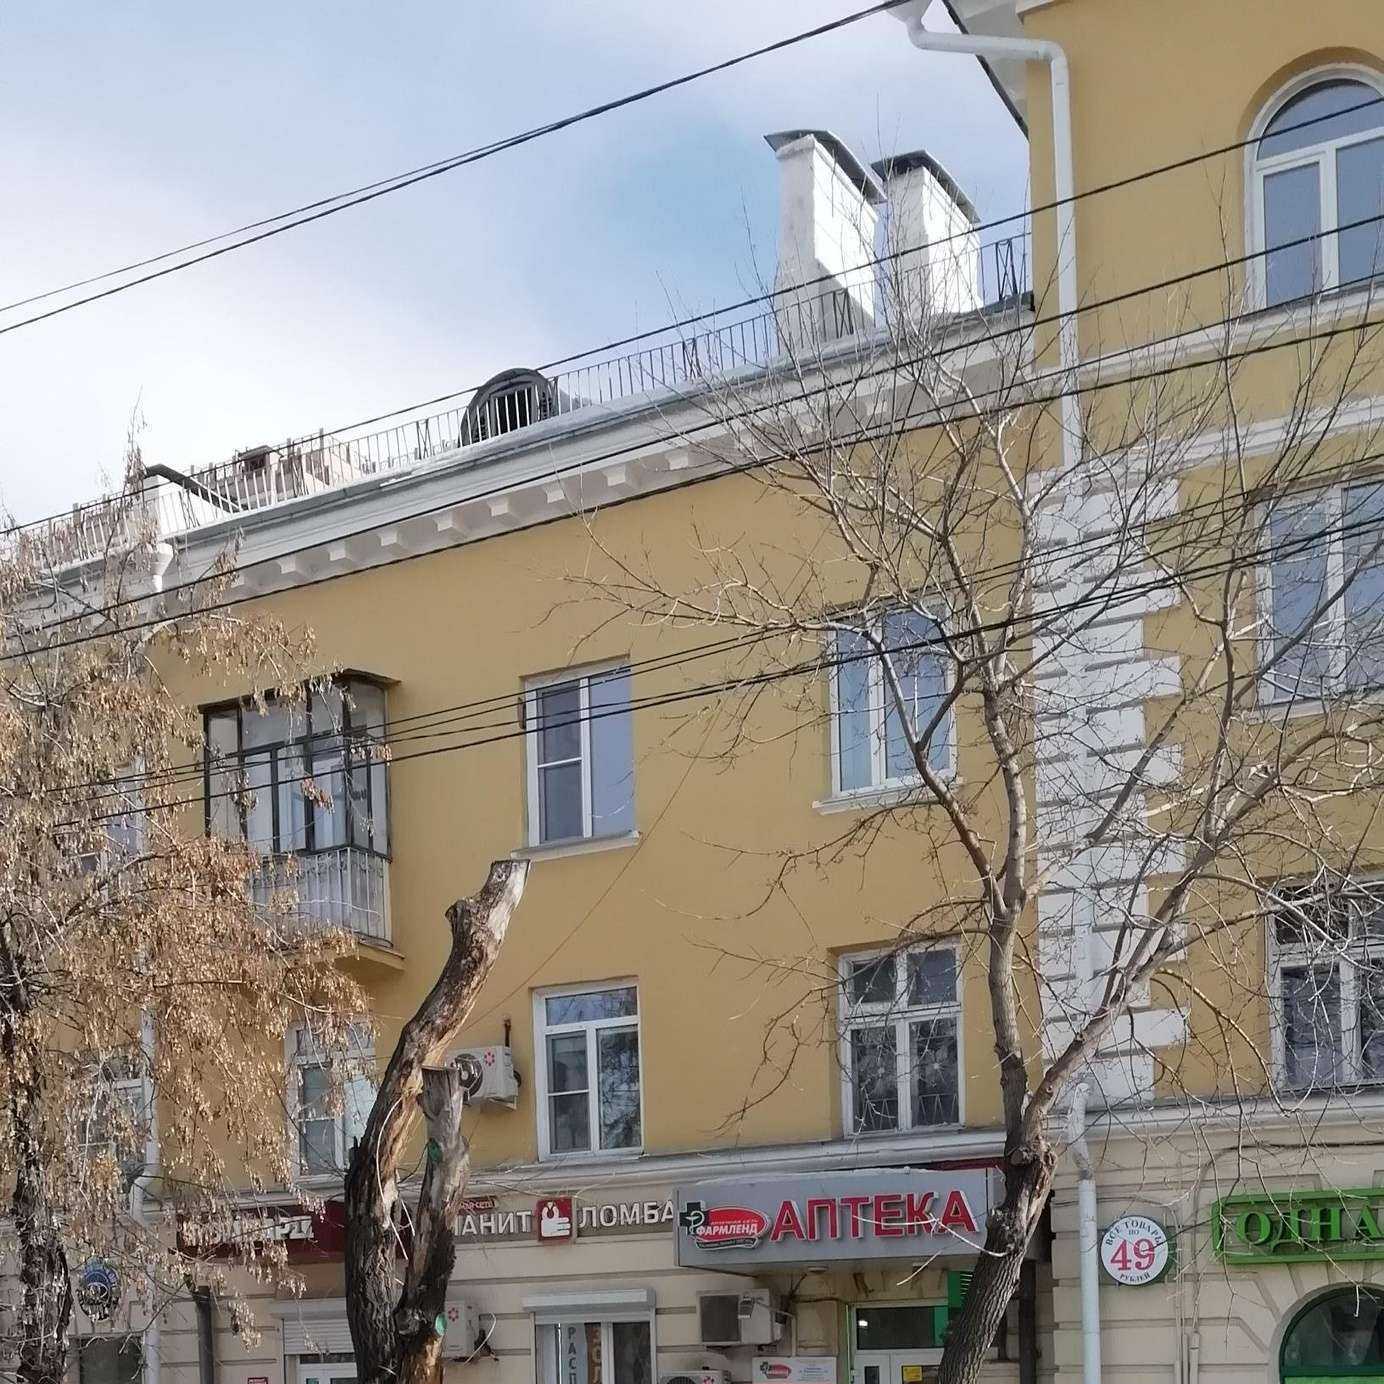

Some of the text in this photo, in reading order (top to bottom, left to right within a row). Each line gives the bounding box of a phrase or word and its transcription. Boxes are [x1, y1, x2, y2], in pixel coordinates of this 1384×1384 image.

[696, 1223, 759, 1236] ФАРМЛЕНД
[770, 1190, 980, 1241] АПТЕКА
[1235, 1204, 1384, 1253] ОДНА
[1105, 1225, 1121, 1246] ВСЕ
[1110, 1238, 1156, 1271] 49
